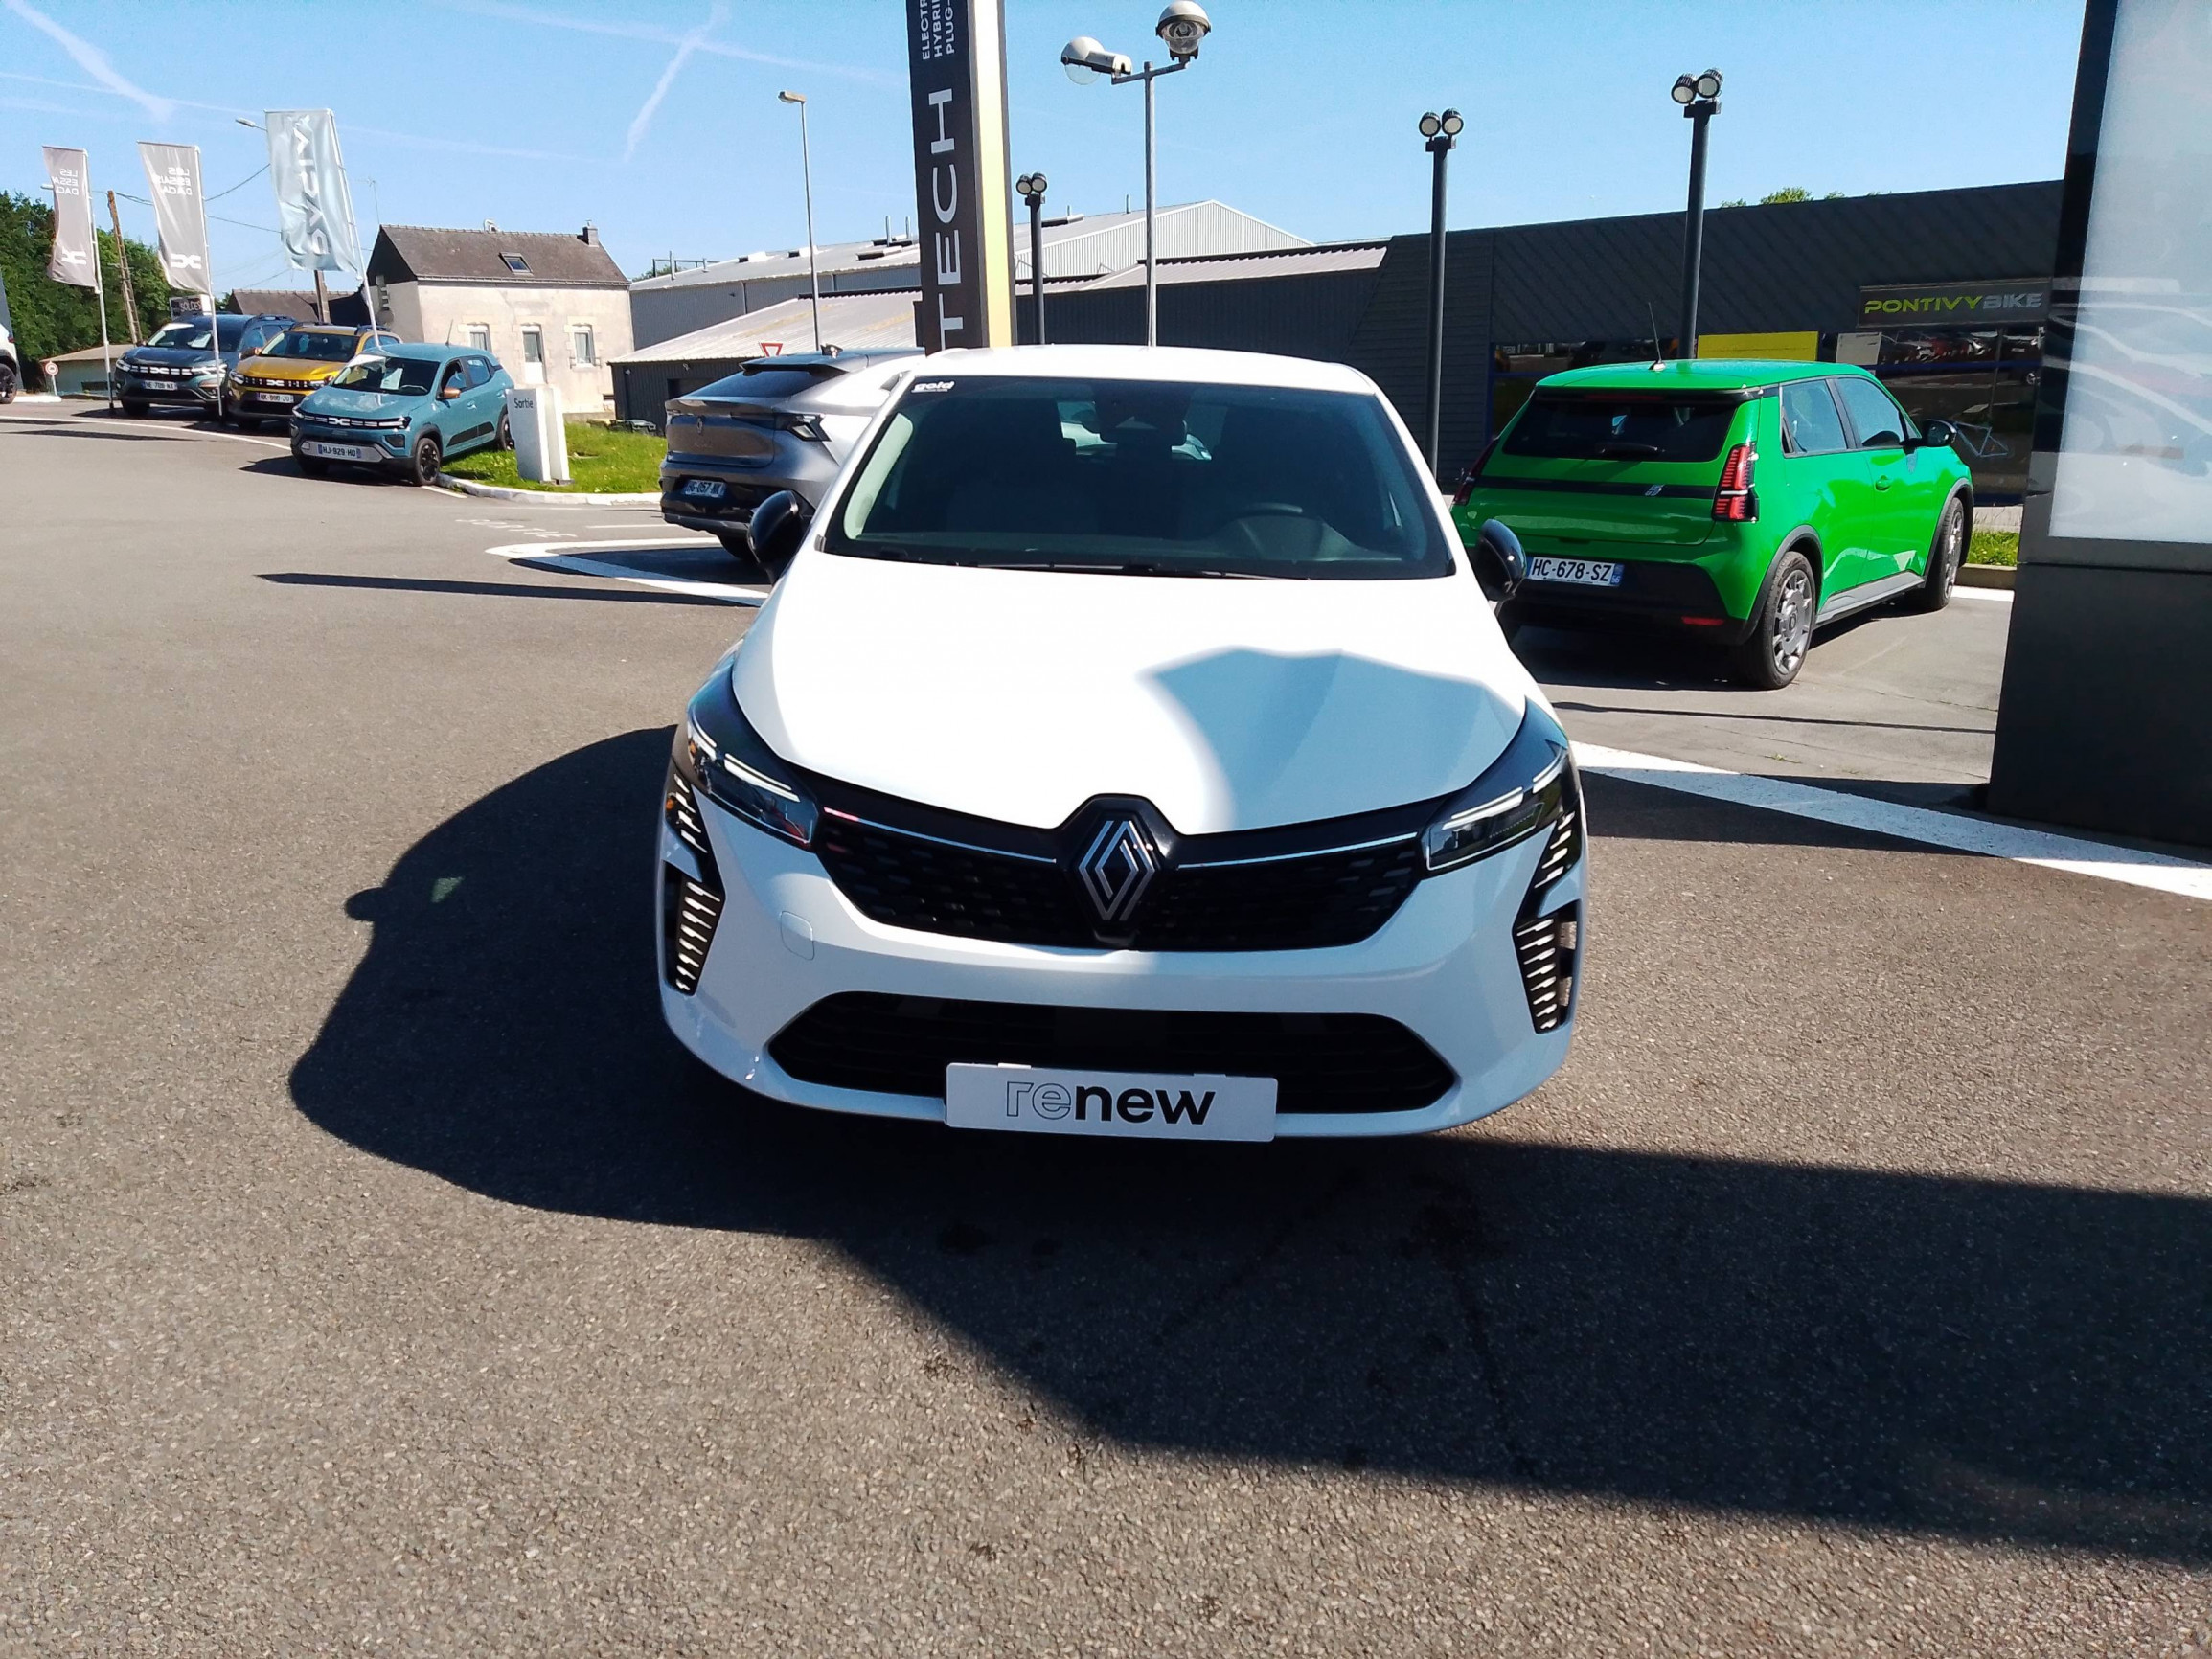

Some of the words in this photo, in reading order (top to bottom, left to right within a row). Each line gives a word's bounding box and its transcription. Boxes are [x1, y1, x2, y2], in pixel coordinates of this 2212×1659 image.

[513, 398, 534, 409] Sortie
[1531, 558, 1612, 582] HC-678-SZ
[1006, 1081, 1217, 1125] renew
